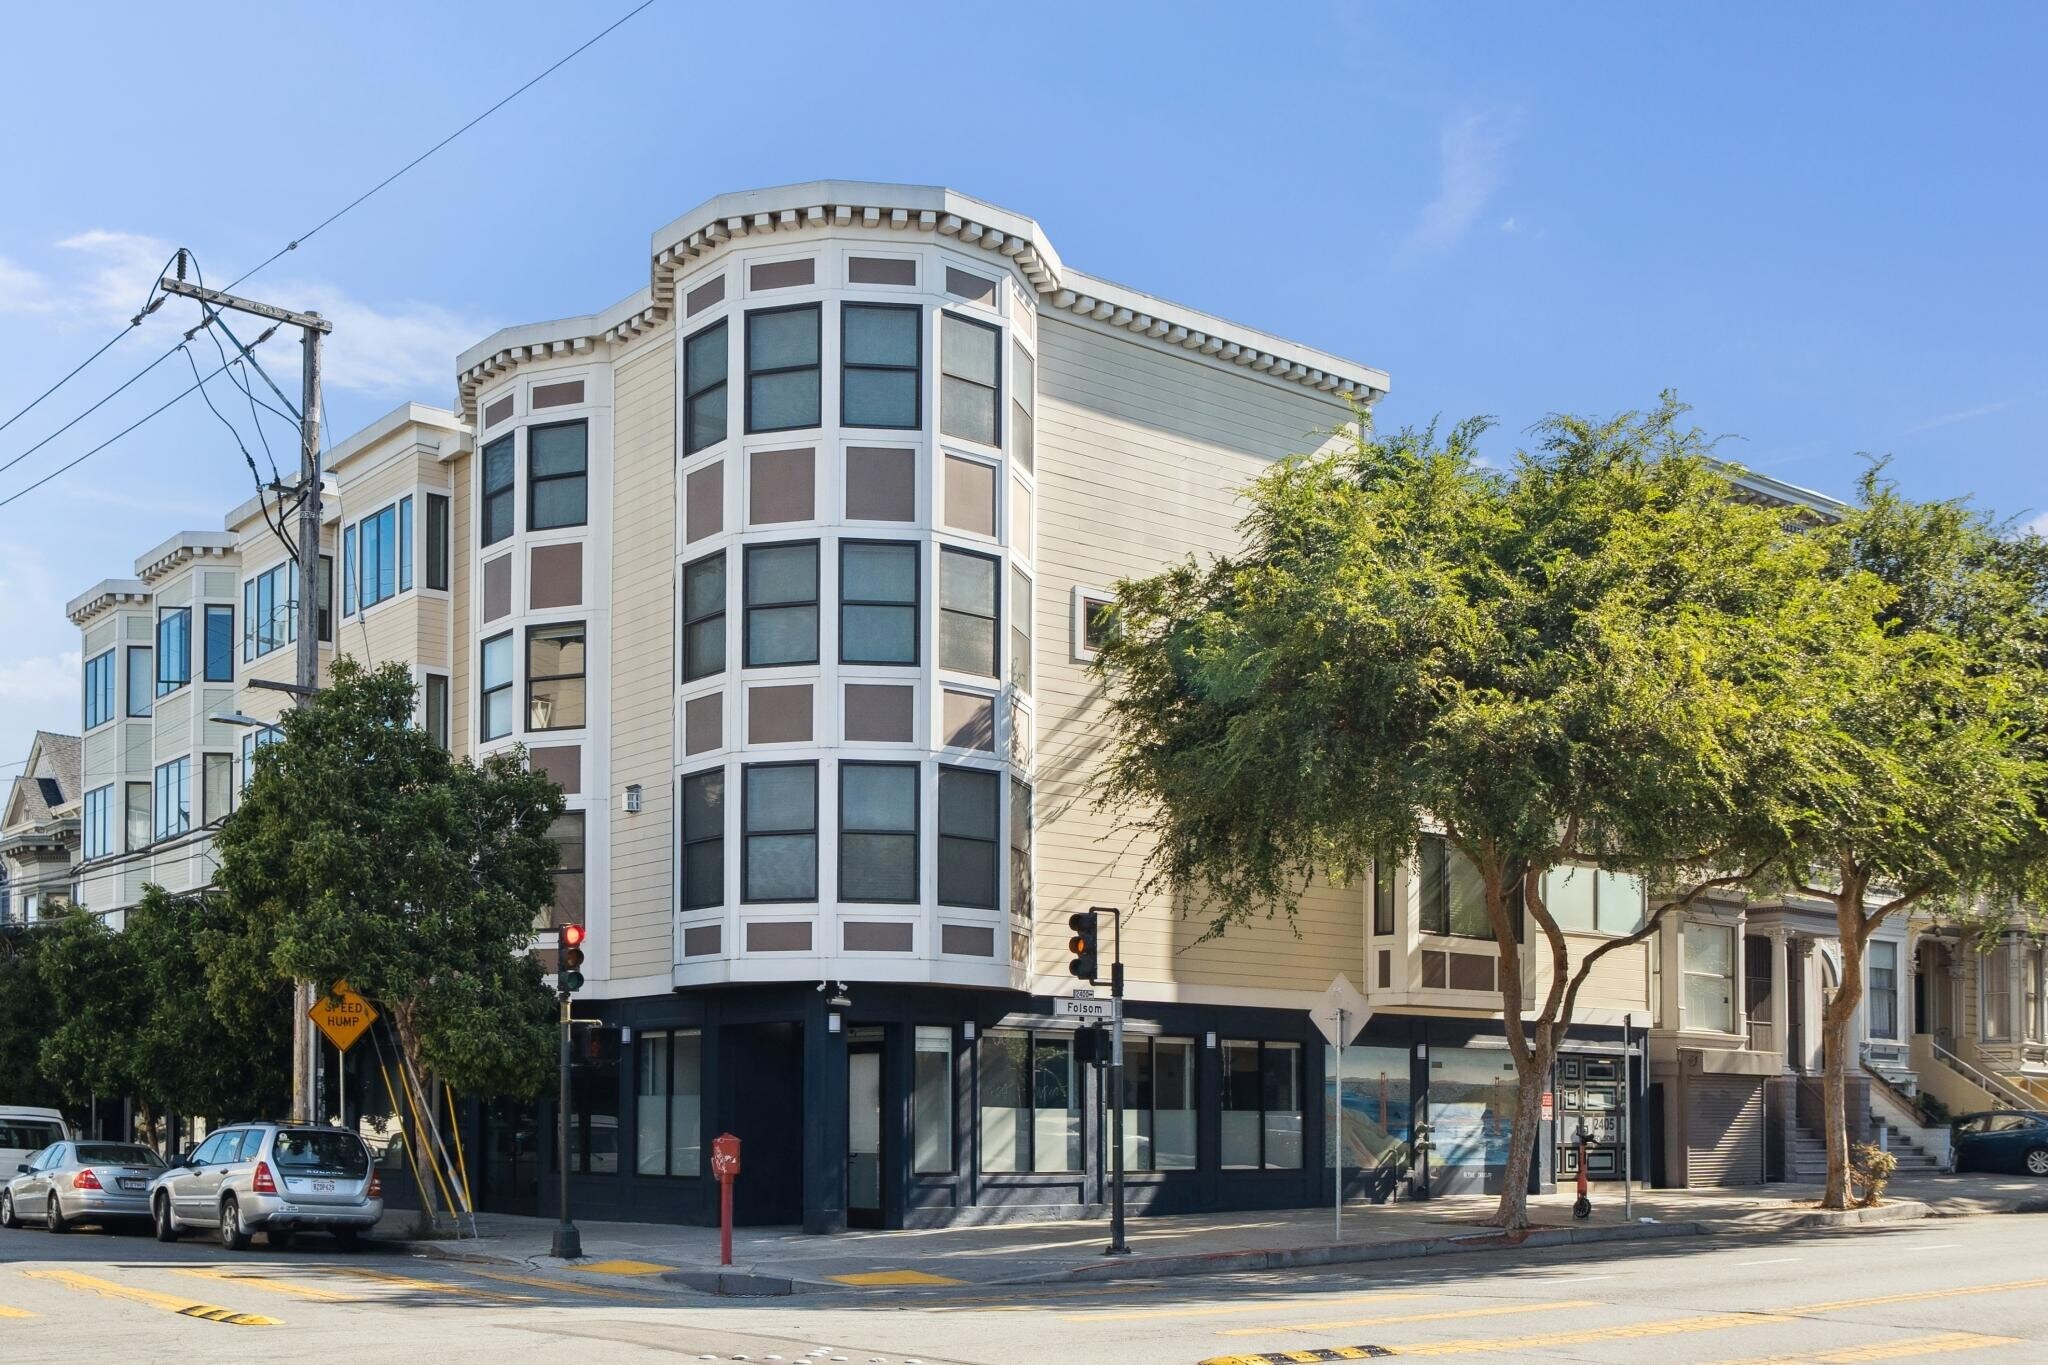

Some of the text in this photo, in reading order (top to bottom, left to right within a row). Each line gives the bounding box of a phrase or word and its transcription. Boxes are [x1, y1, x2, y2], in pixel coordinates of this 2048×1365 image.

[1067, 1002, 1103, 1013] Folsom
[328, 1016, 359, 1027] HUMP
[1594, 1118, 1615, 1130] 2405
